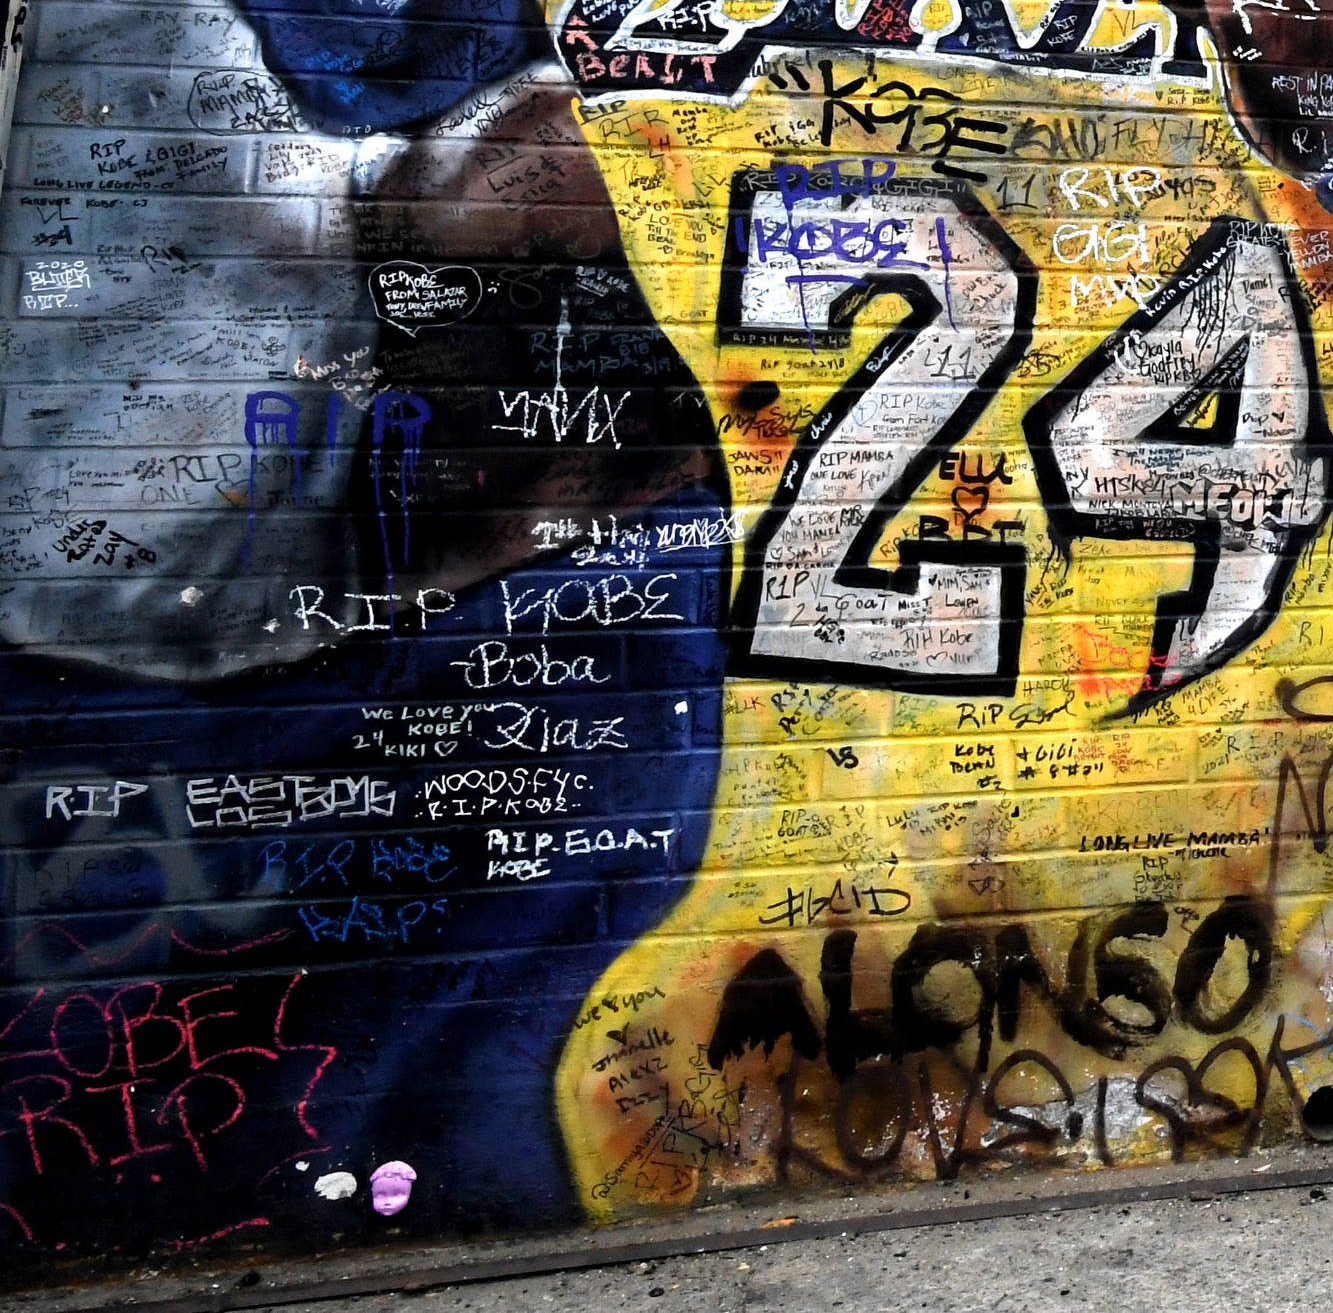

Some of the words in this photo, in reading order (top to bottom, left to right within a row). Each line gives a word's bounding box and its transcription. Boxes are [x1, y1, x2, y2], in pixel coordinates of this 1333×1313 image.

[1059, 168, 1161, 211] RIP
[879, 394, 911, 409] RIP
[819, 451, 848, 468] RIP
[850, 450, 895, 464] MAMBA
[169, 454, 242, 483] RIP
[385, 743, 427, 757] KIKI
